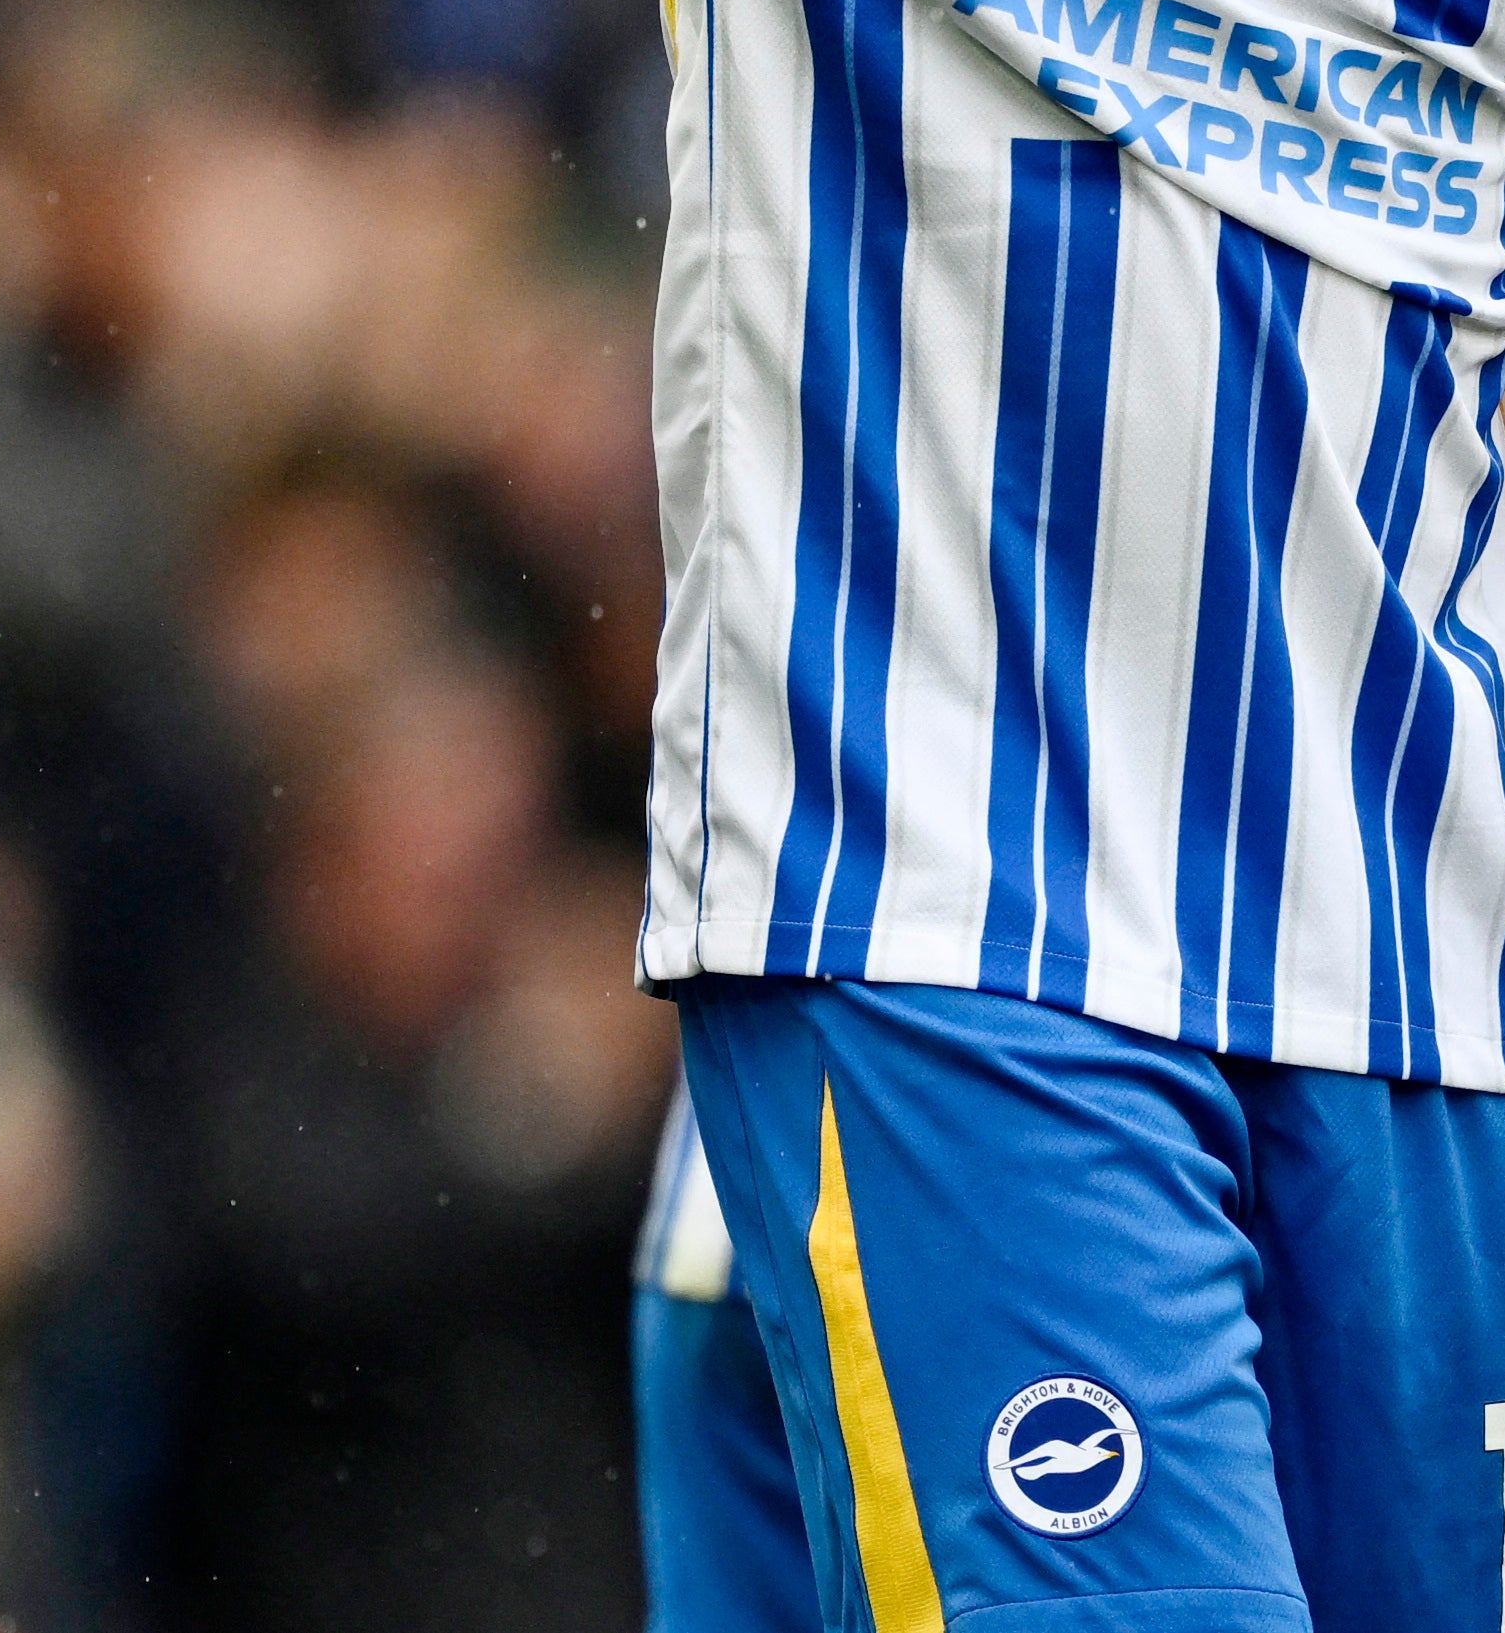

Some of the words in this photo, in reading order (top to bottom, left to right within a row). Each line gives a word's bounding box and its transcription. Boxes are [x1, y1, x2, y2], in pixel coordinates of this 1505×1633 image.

[1038, 58, 1484, 235] EXPRESS
[998, 1383, 1059, 1436] BRIGHTON
[1066, 1382, 1076, 1394] &
[1083, 1386, 1120, 1414] HOVE
[1050, 1507, 1109, 1529] ALBION
